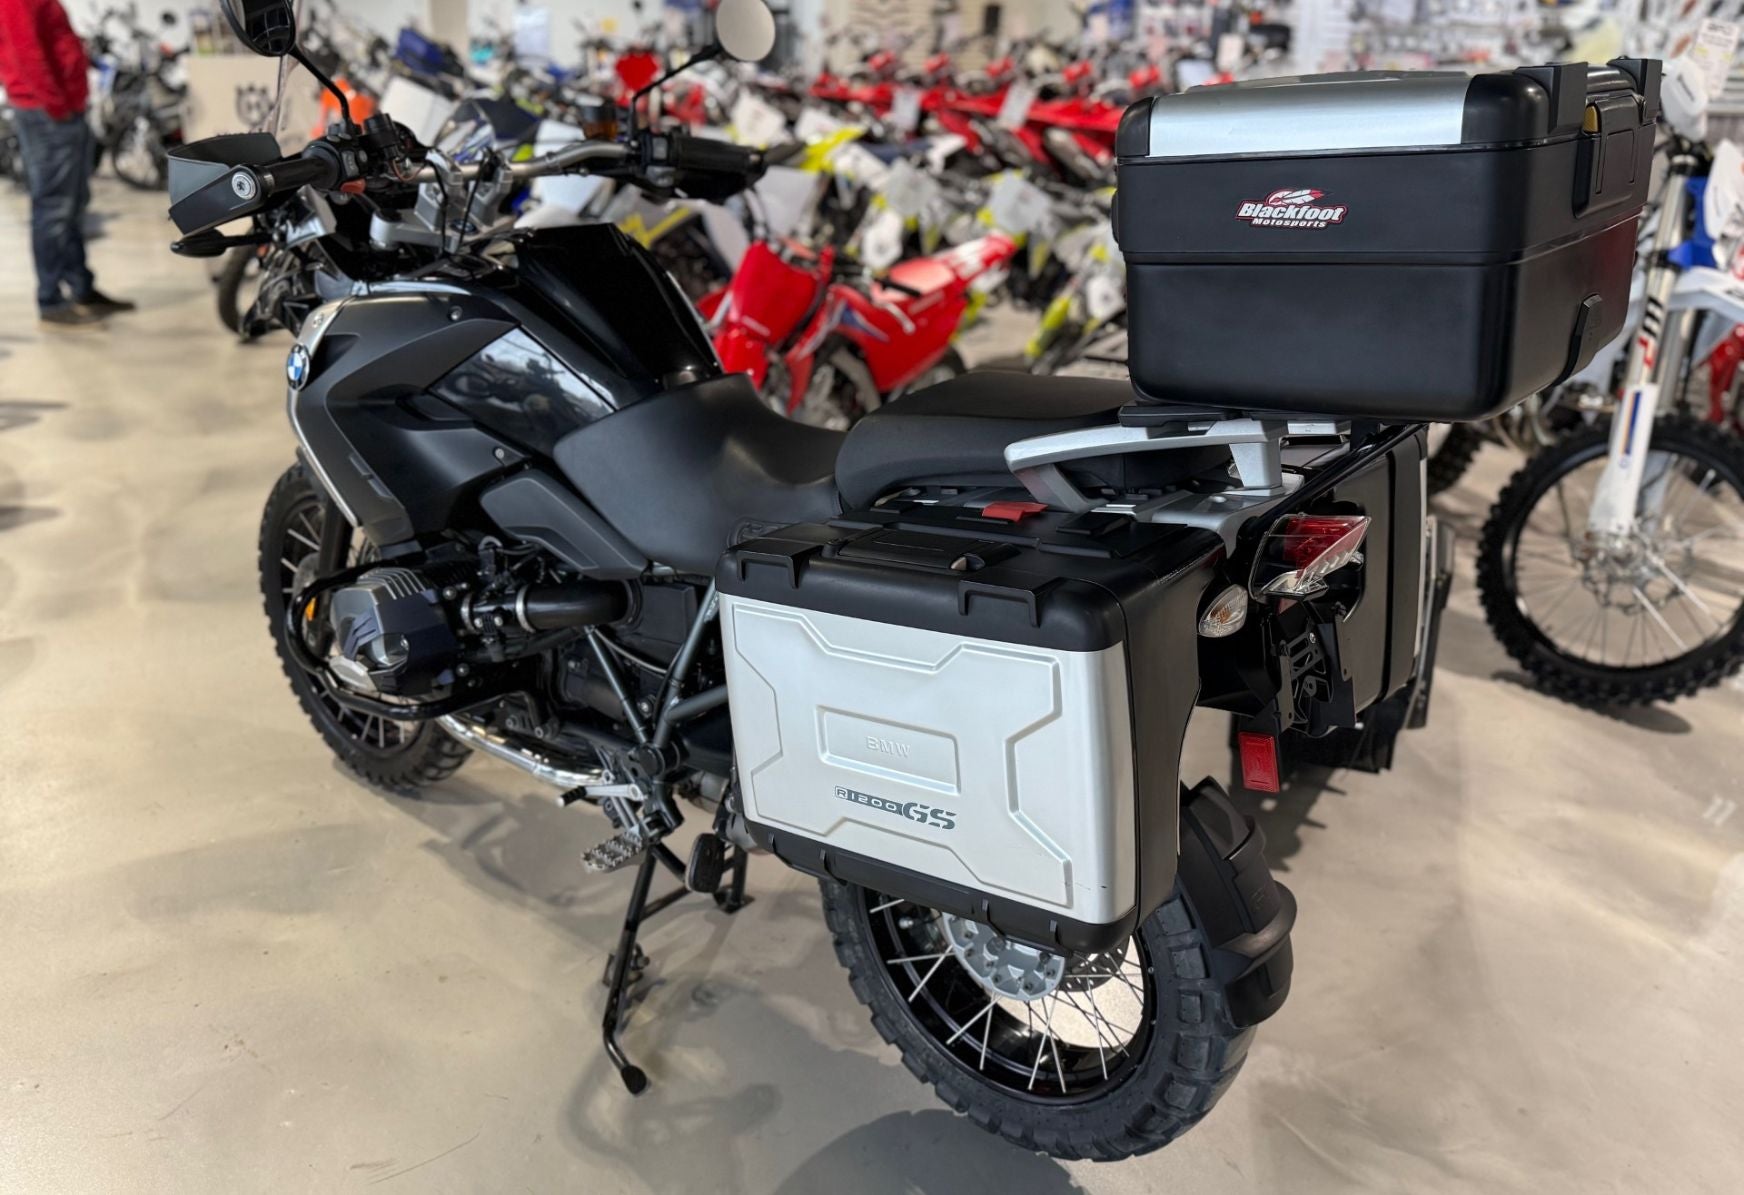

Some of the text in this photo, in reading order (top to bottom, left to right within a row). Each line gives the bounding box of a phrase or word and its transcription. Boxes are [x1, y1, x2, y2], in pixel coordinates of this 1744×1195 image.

[1238, 202, 1344, 221] Blackfoot
[1252, 217, 1327, 228] Motosports
[866, 735, 911, 758] BMW
